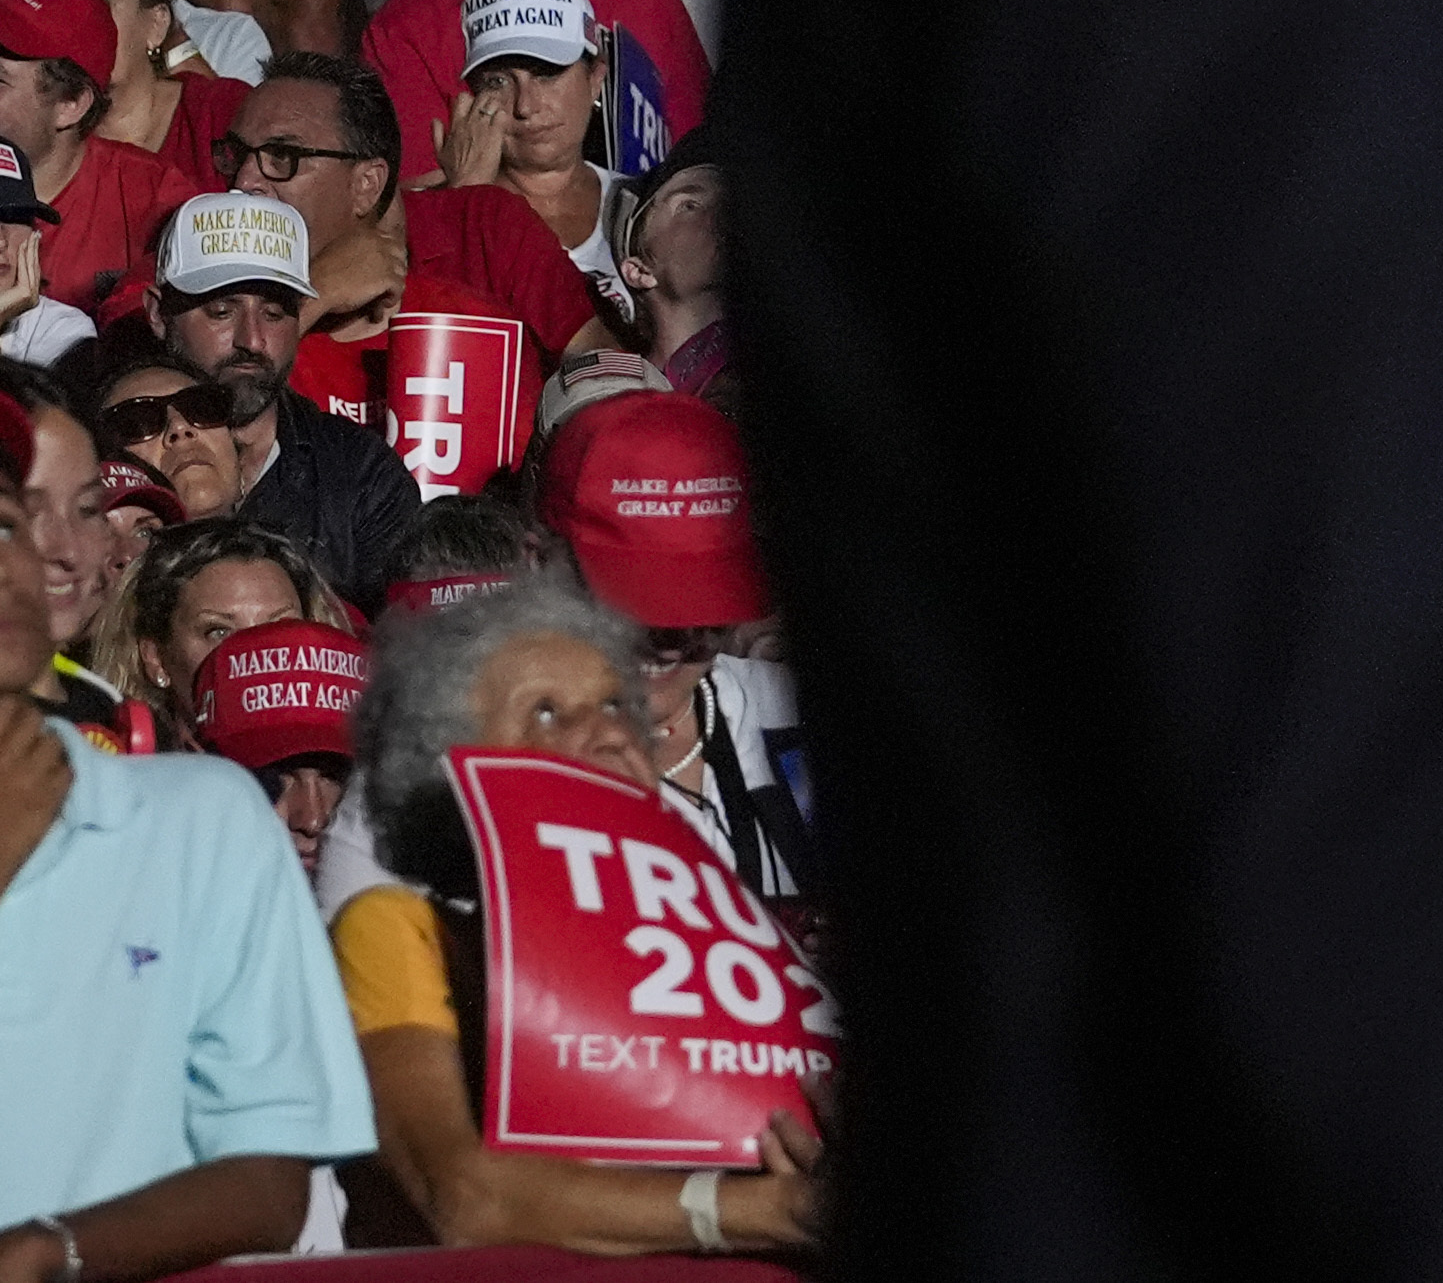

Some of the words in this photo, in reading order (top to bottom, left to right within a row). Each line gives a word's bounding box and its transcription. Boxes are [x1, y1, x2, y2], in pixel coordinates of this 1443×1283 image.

[514, 7, 564, 29] AGAIN
[192, 210, 236, 236] MAKE
[238, 207, 299, 242] AMERICA
[200, 231, 250, 257] GREAT
[253, 233, 293, 262] AGAIN
[611, 478, 669, 495] MAKE
[617, 500, 685, 516] GREAT
[228, 647, 291, 680] MAKE
[241, 681, 312, 714] GREAT
[550, 1033, 666, 1072] TEXT
[680, 1037, 833, 1078] TRUMP
